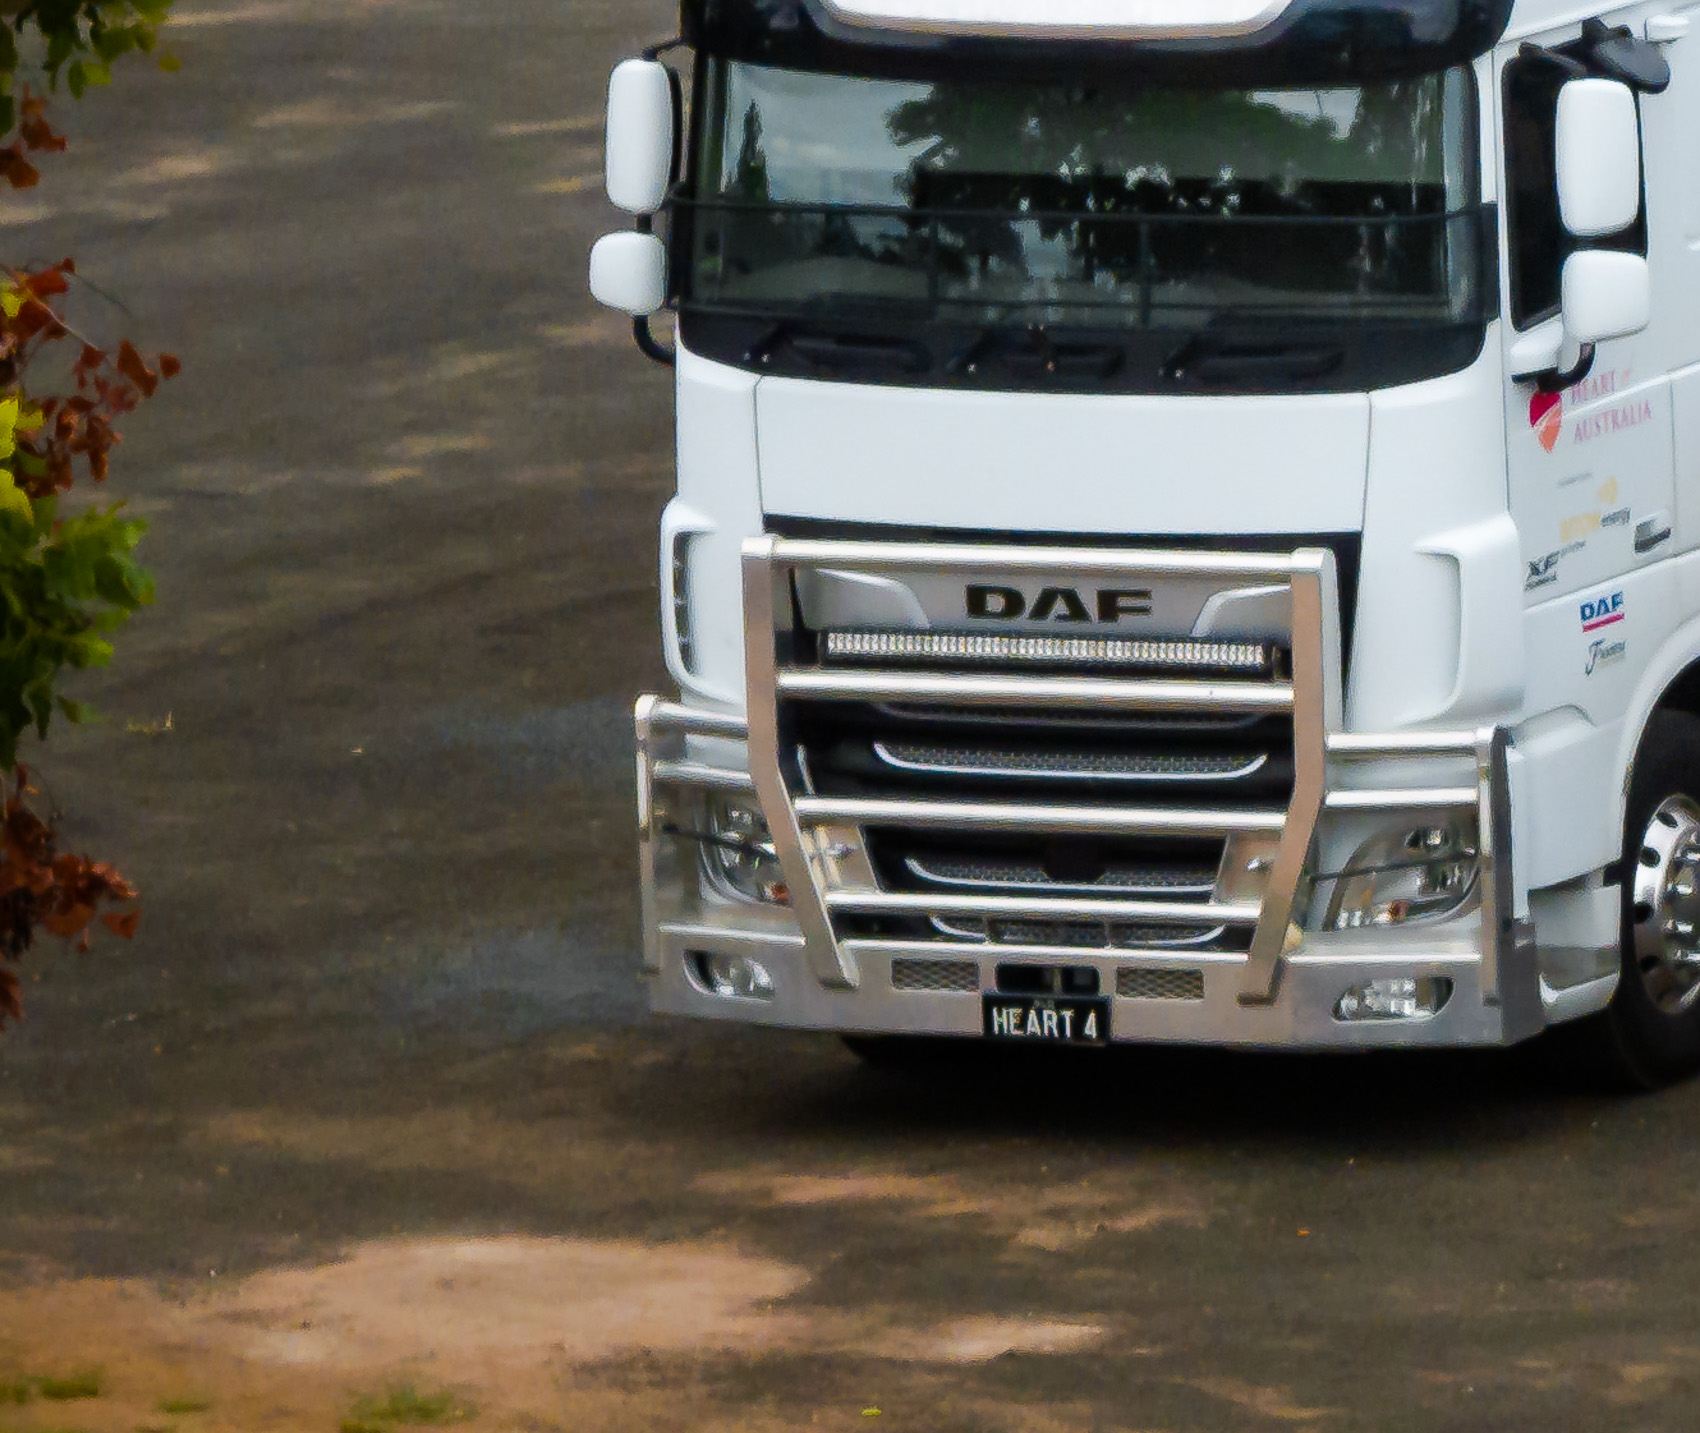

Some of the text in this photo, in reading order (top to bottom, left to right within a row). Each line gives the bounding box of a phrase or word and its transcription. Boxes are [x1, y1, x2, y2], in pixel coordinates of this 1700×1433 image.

[1573, 399, 1653, 444] AUSTRALIA
[966, 584, 1153, 624] DAF
[1580, 590, 1625, 622] DAF
[992, 1006, 1098, 1039] HEART 4
